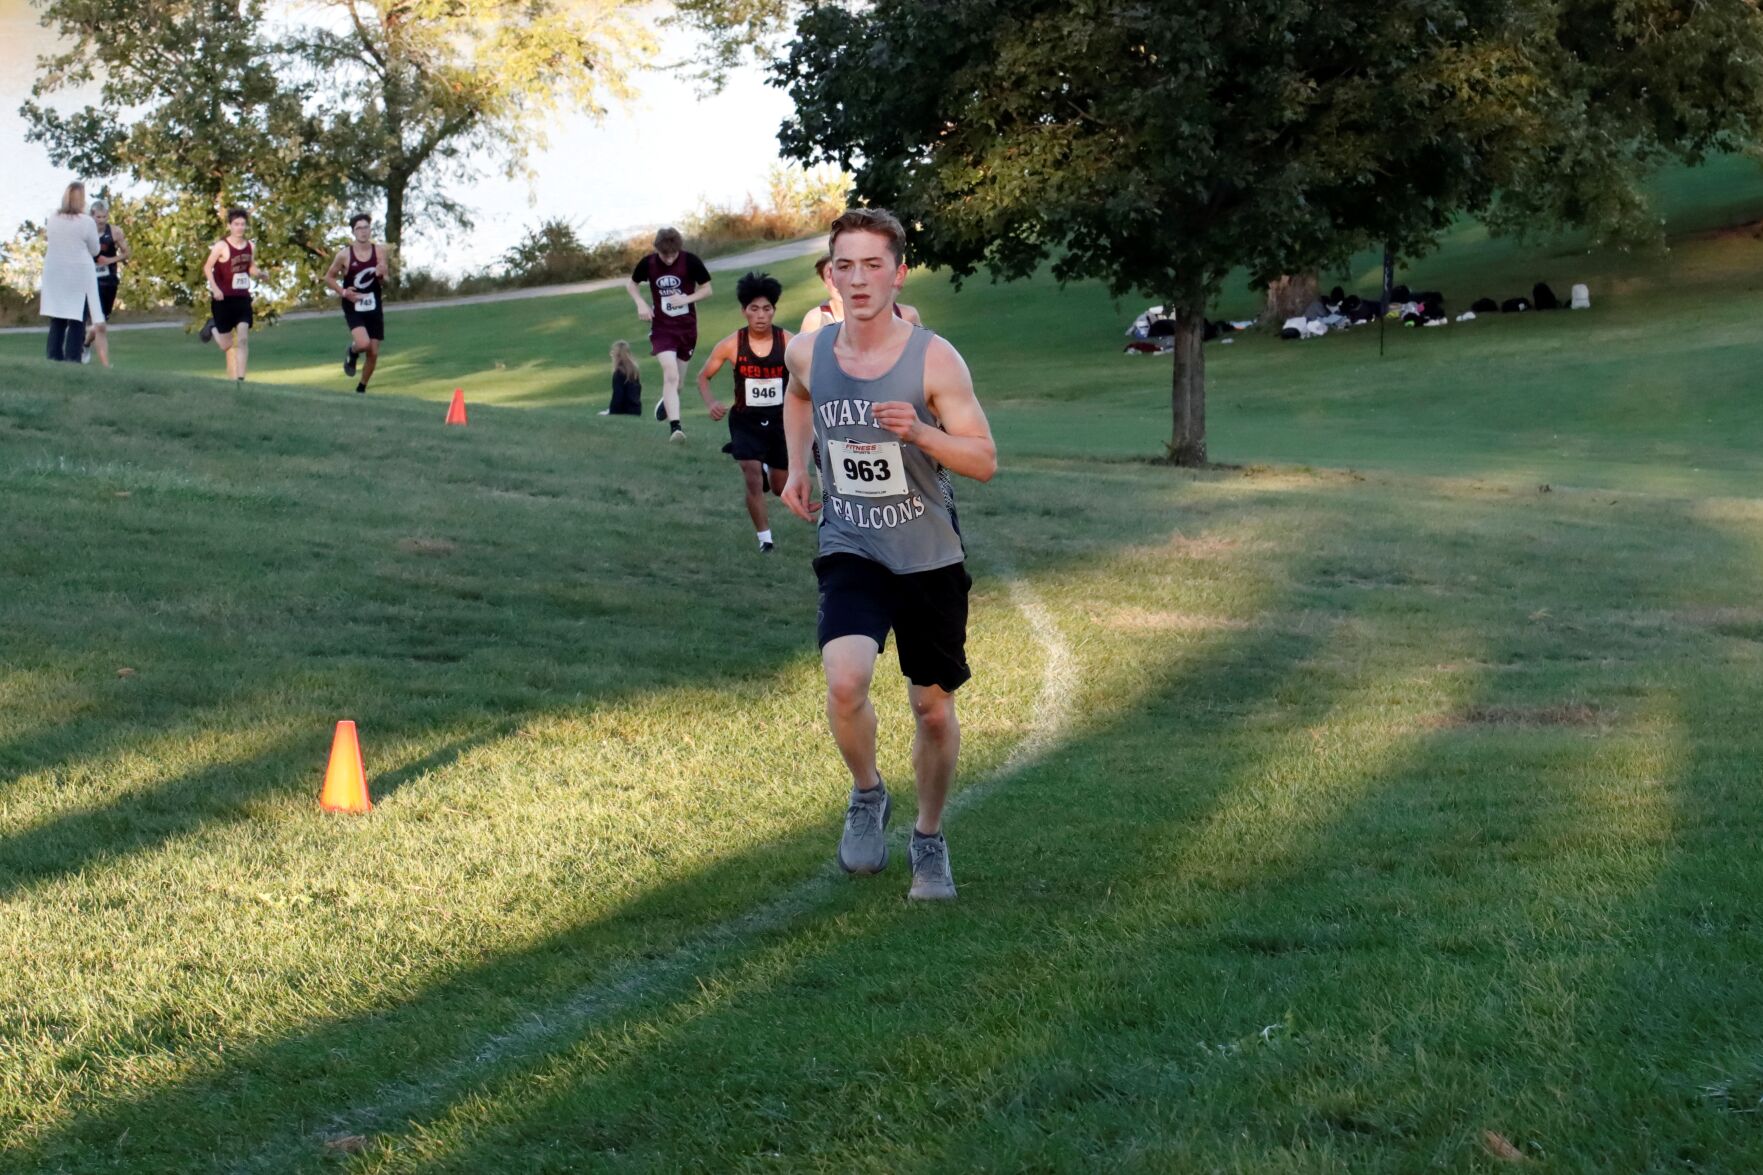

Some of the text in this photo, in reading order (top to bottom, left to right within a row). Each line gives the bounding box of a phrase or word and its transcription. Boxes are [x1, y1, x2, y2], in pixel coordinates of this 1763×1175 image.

[752, 387, 776, 399] 946
[819, 399, 881, 429] WAY
[843, 458, 891, 482] 963
[830, 496, 926, 530] FALCONS
